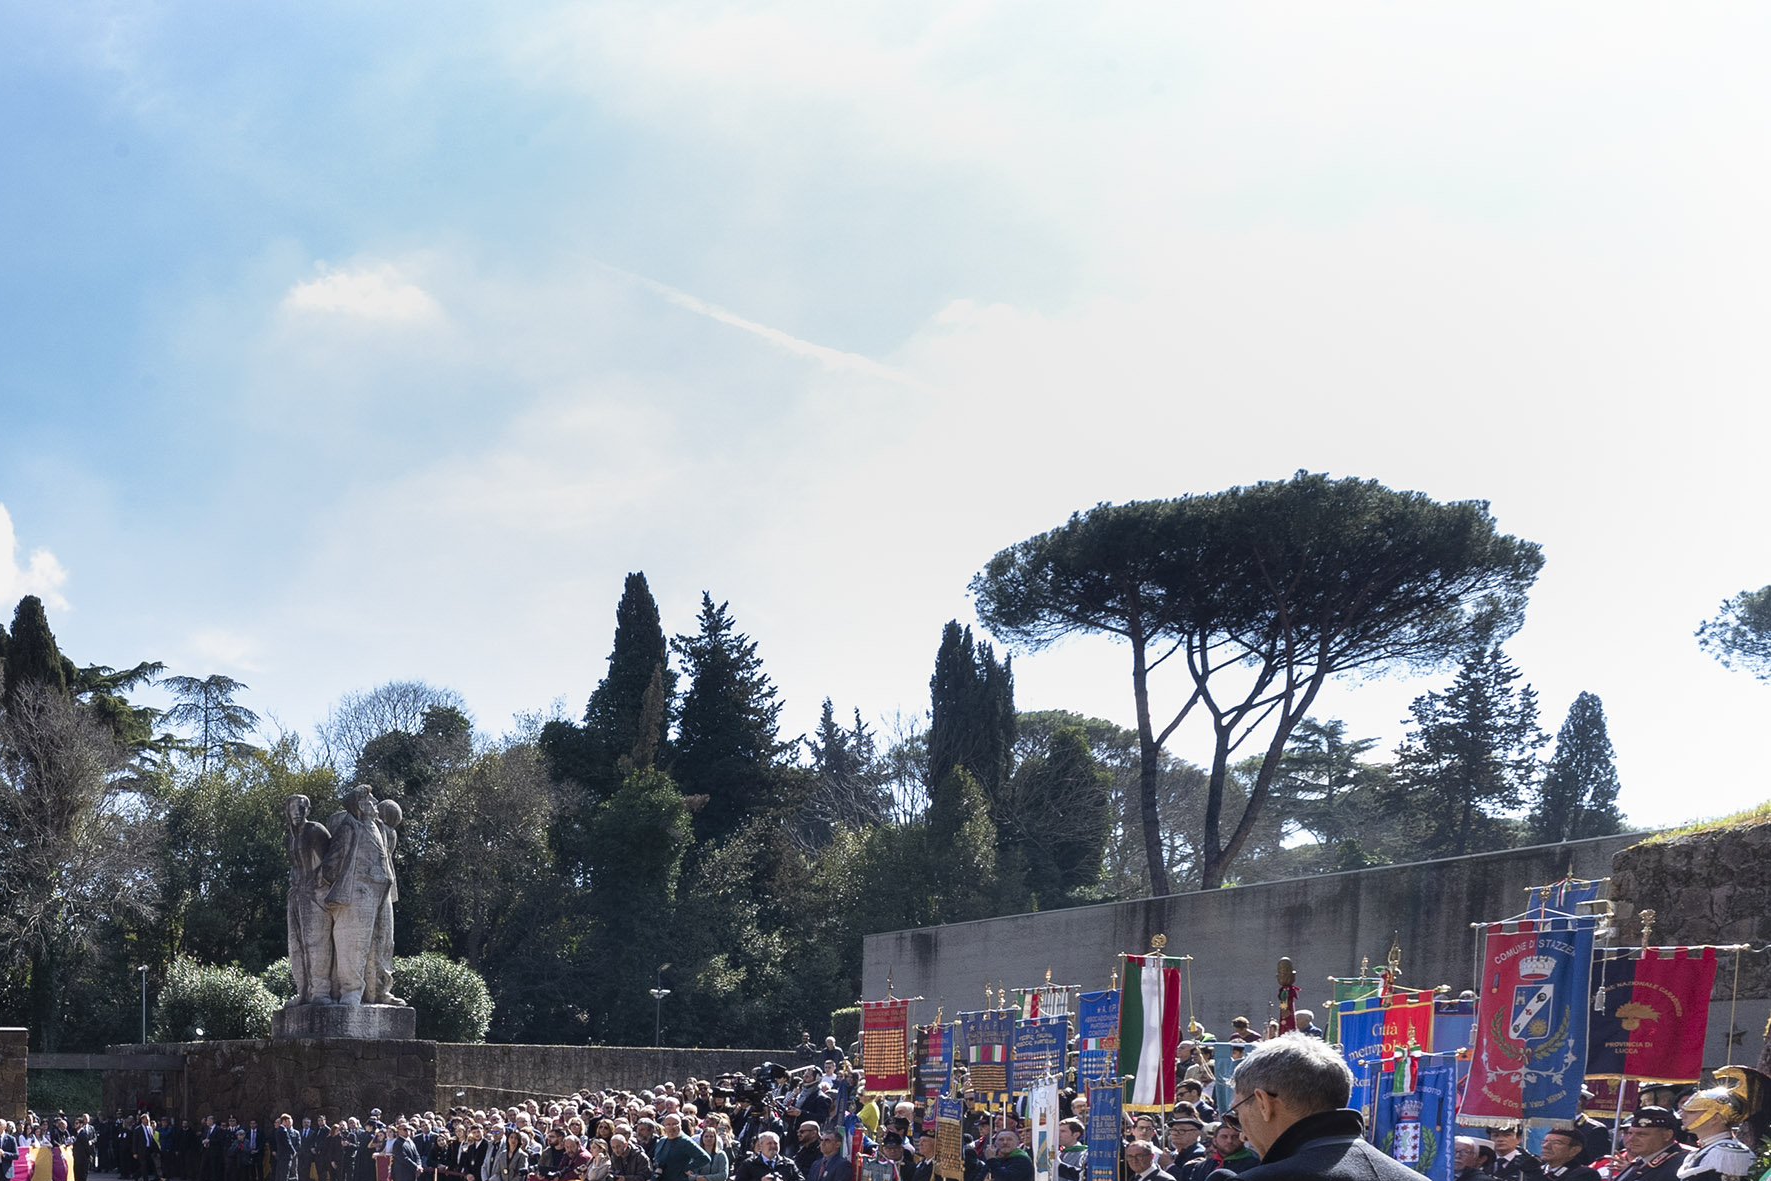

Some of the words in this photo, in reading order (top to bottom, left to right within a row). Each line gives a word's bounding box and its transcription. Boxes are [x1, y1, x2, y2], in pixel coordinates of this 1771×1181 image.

[1494, 942, 1527, 965] COMUNE
[1538, 939, 1576, 957] STAZZE
[1616, 980, 1658, 991] NAZIONALE
[1372, 1021, 1399, 1037] Città
[1348, 1039, 1410, 1062] metropol
